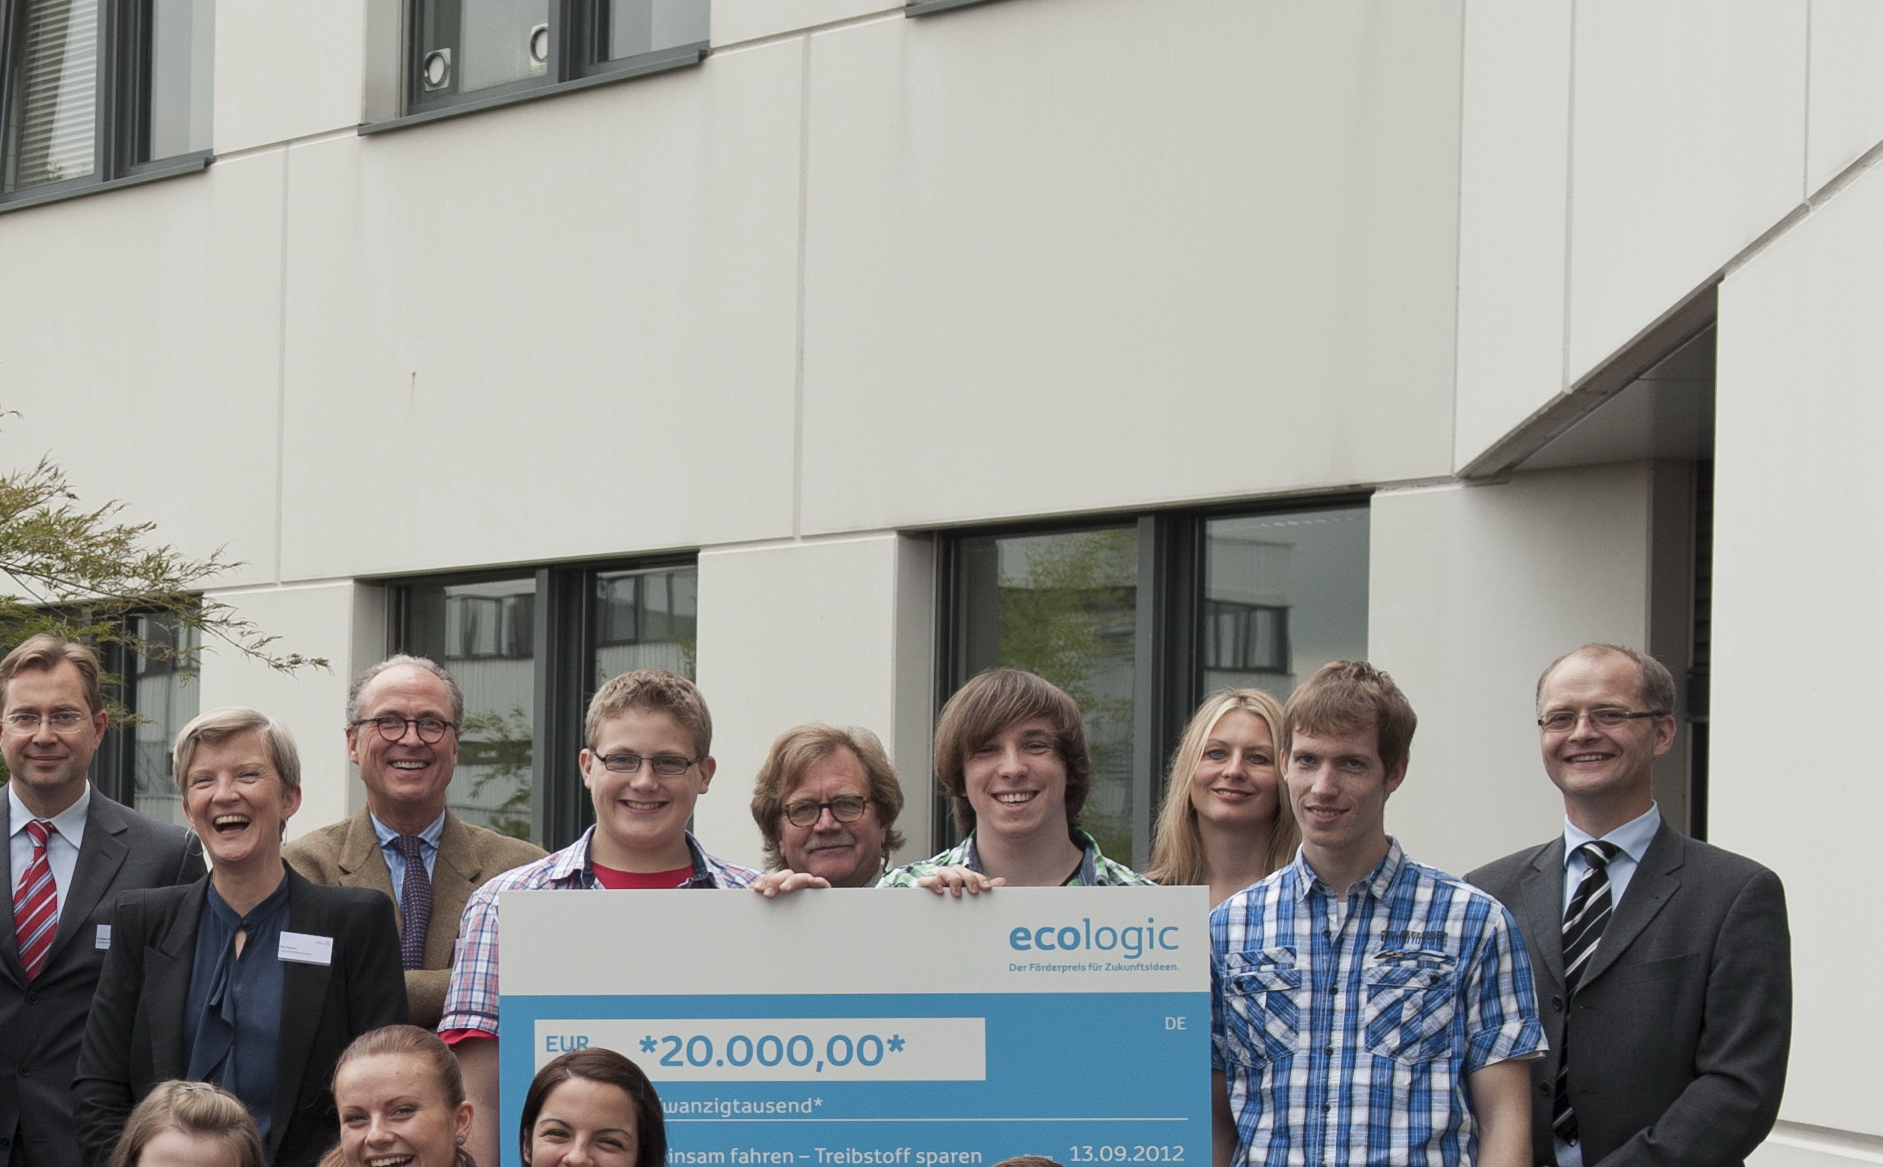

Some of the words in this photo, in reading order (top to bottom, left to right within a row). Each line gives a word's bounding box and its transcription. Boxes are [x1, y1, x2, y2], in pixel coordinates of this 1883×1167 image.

[1008, 916, 1179, 959] ecologic
[1008, 962, 1027, 972] Der
[1028, 962, 1086, 974] Förderpreis
[1087, 962, 1103, 972] für
[1104, 961, 1179, 971] Zukunftsideen.
[1164, 1016, 1187, 1030] DE
[545, 1034, 590, 1052] EUR
[660, 1097, 823, 1118] wanzigtausend
[667, 1147, 726, 1165] insam
[730, 1148, 794, 1165] fahren
[814, 1148, 911, 1165] Treibstoff
[916, 1151, 983, 1167] sparen
[1069, 1144, 1184, 1162] 13.09.2012
